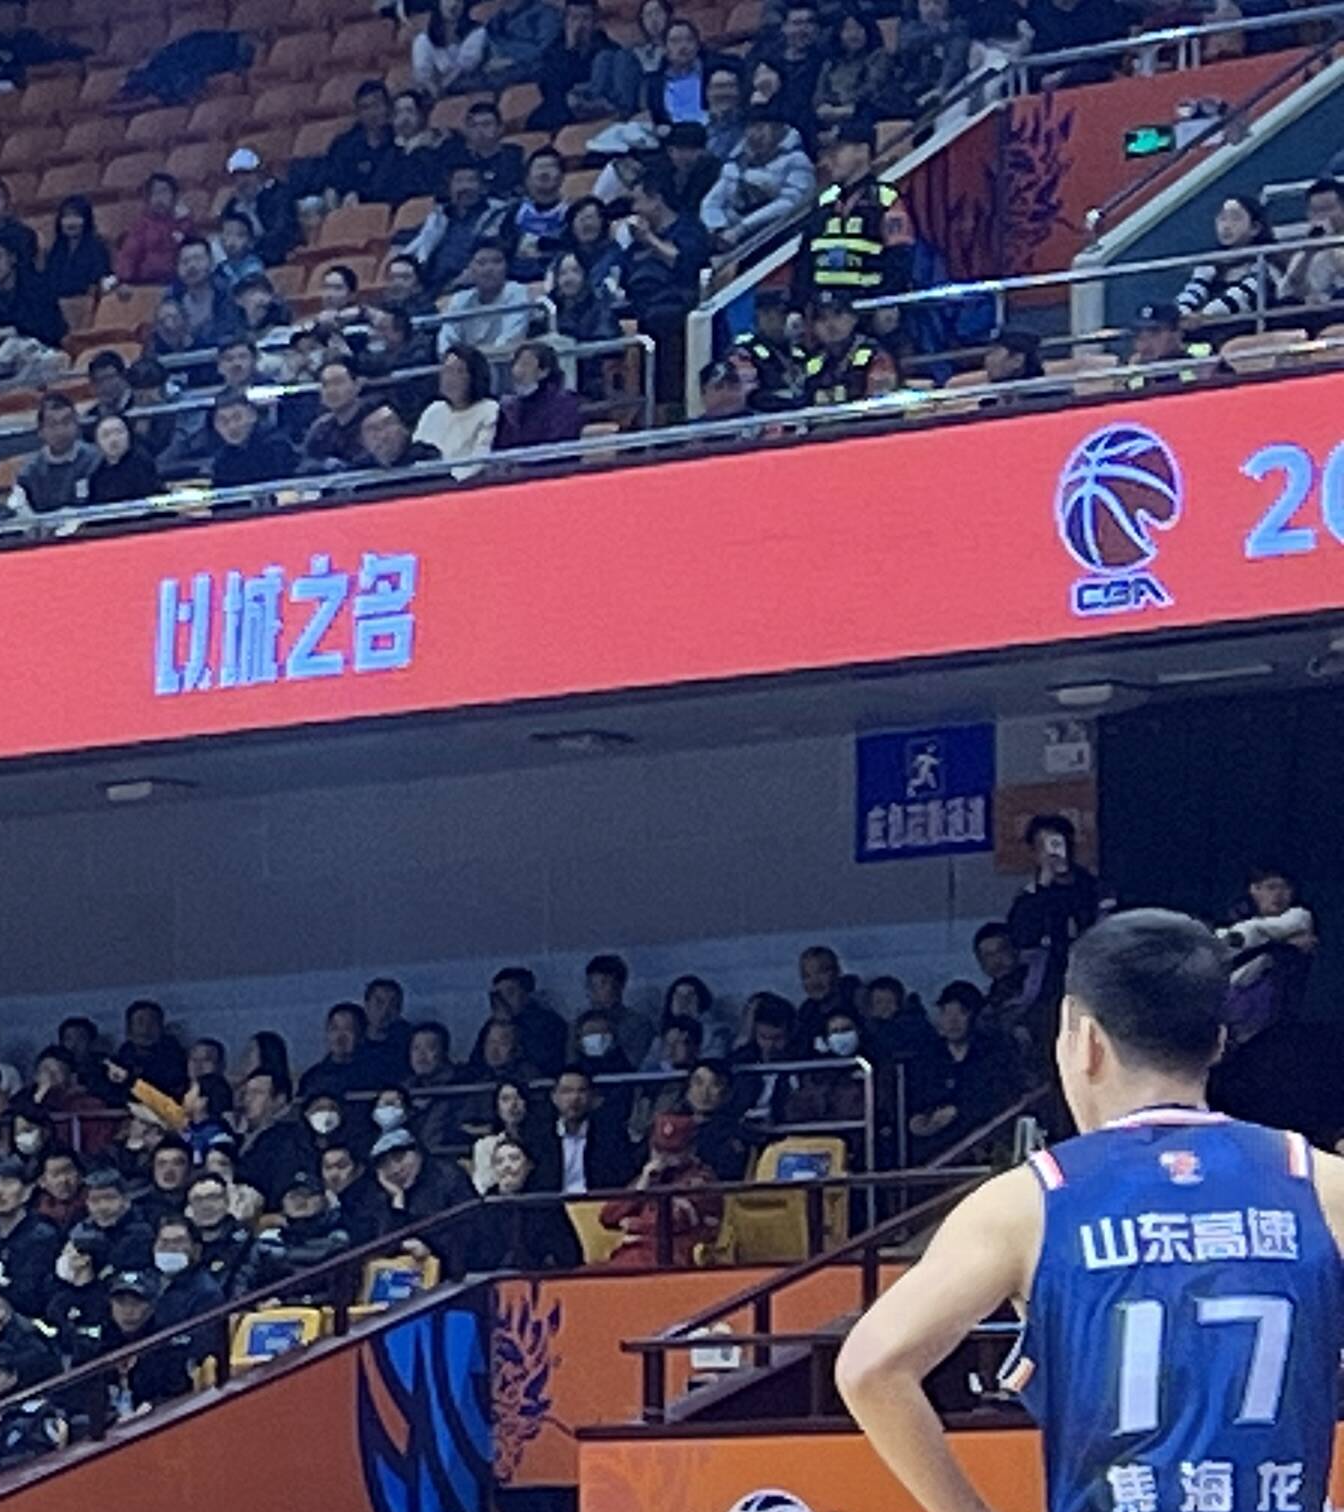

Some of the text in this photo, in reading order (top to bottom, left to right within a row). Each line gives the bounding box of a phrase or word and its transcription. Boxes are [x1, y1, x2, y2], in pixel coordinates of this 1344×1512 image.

[154, 553, 418, 696] 以城之名
[1071, 575, 1173, 616] CBA
[1079, 1207, 1301, 1271] 山东高速
[1112, 1297, 1295, 1435] 17
